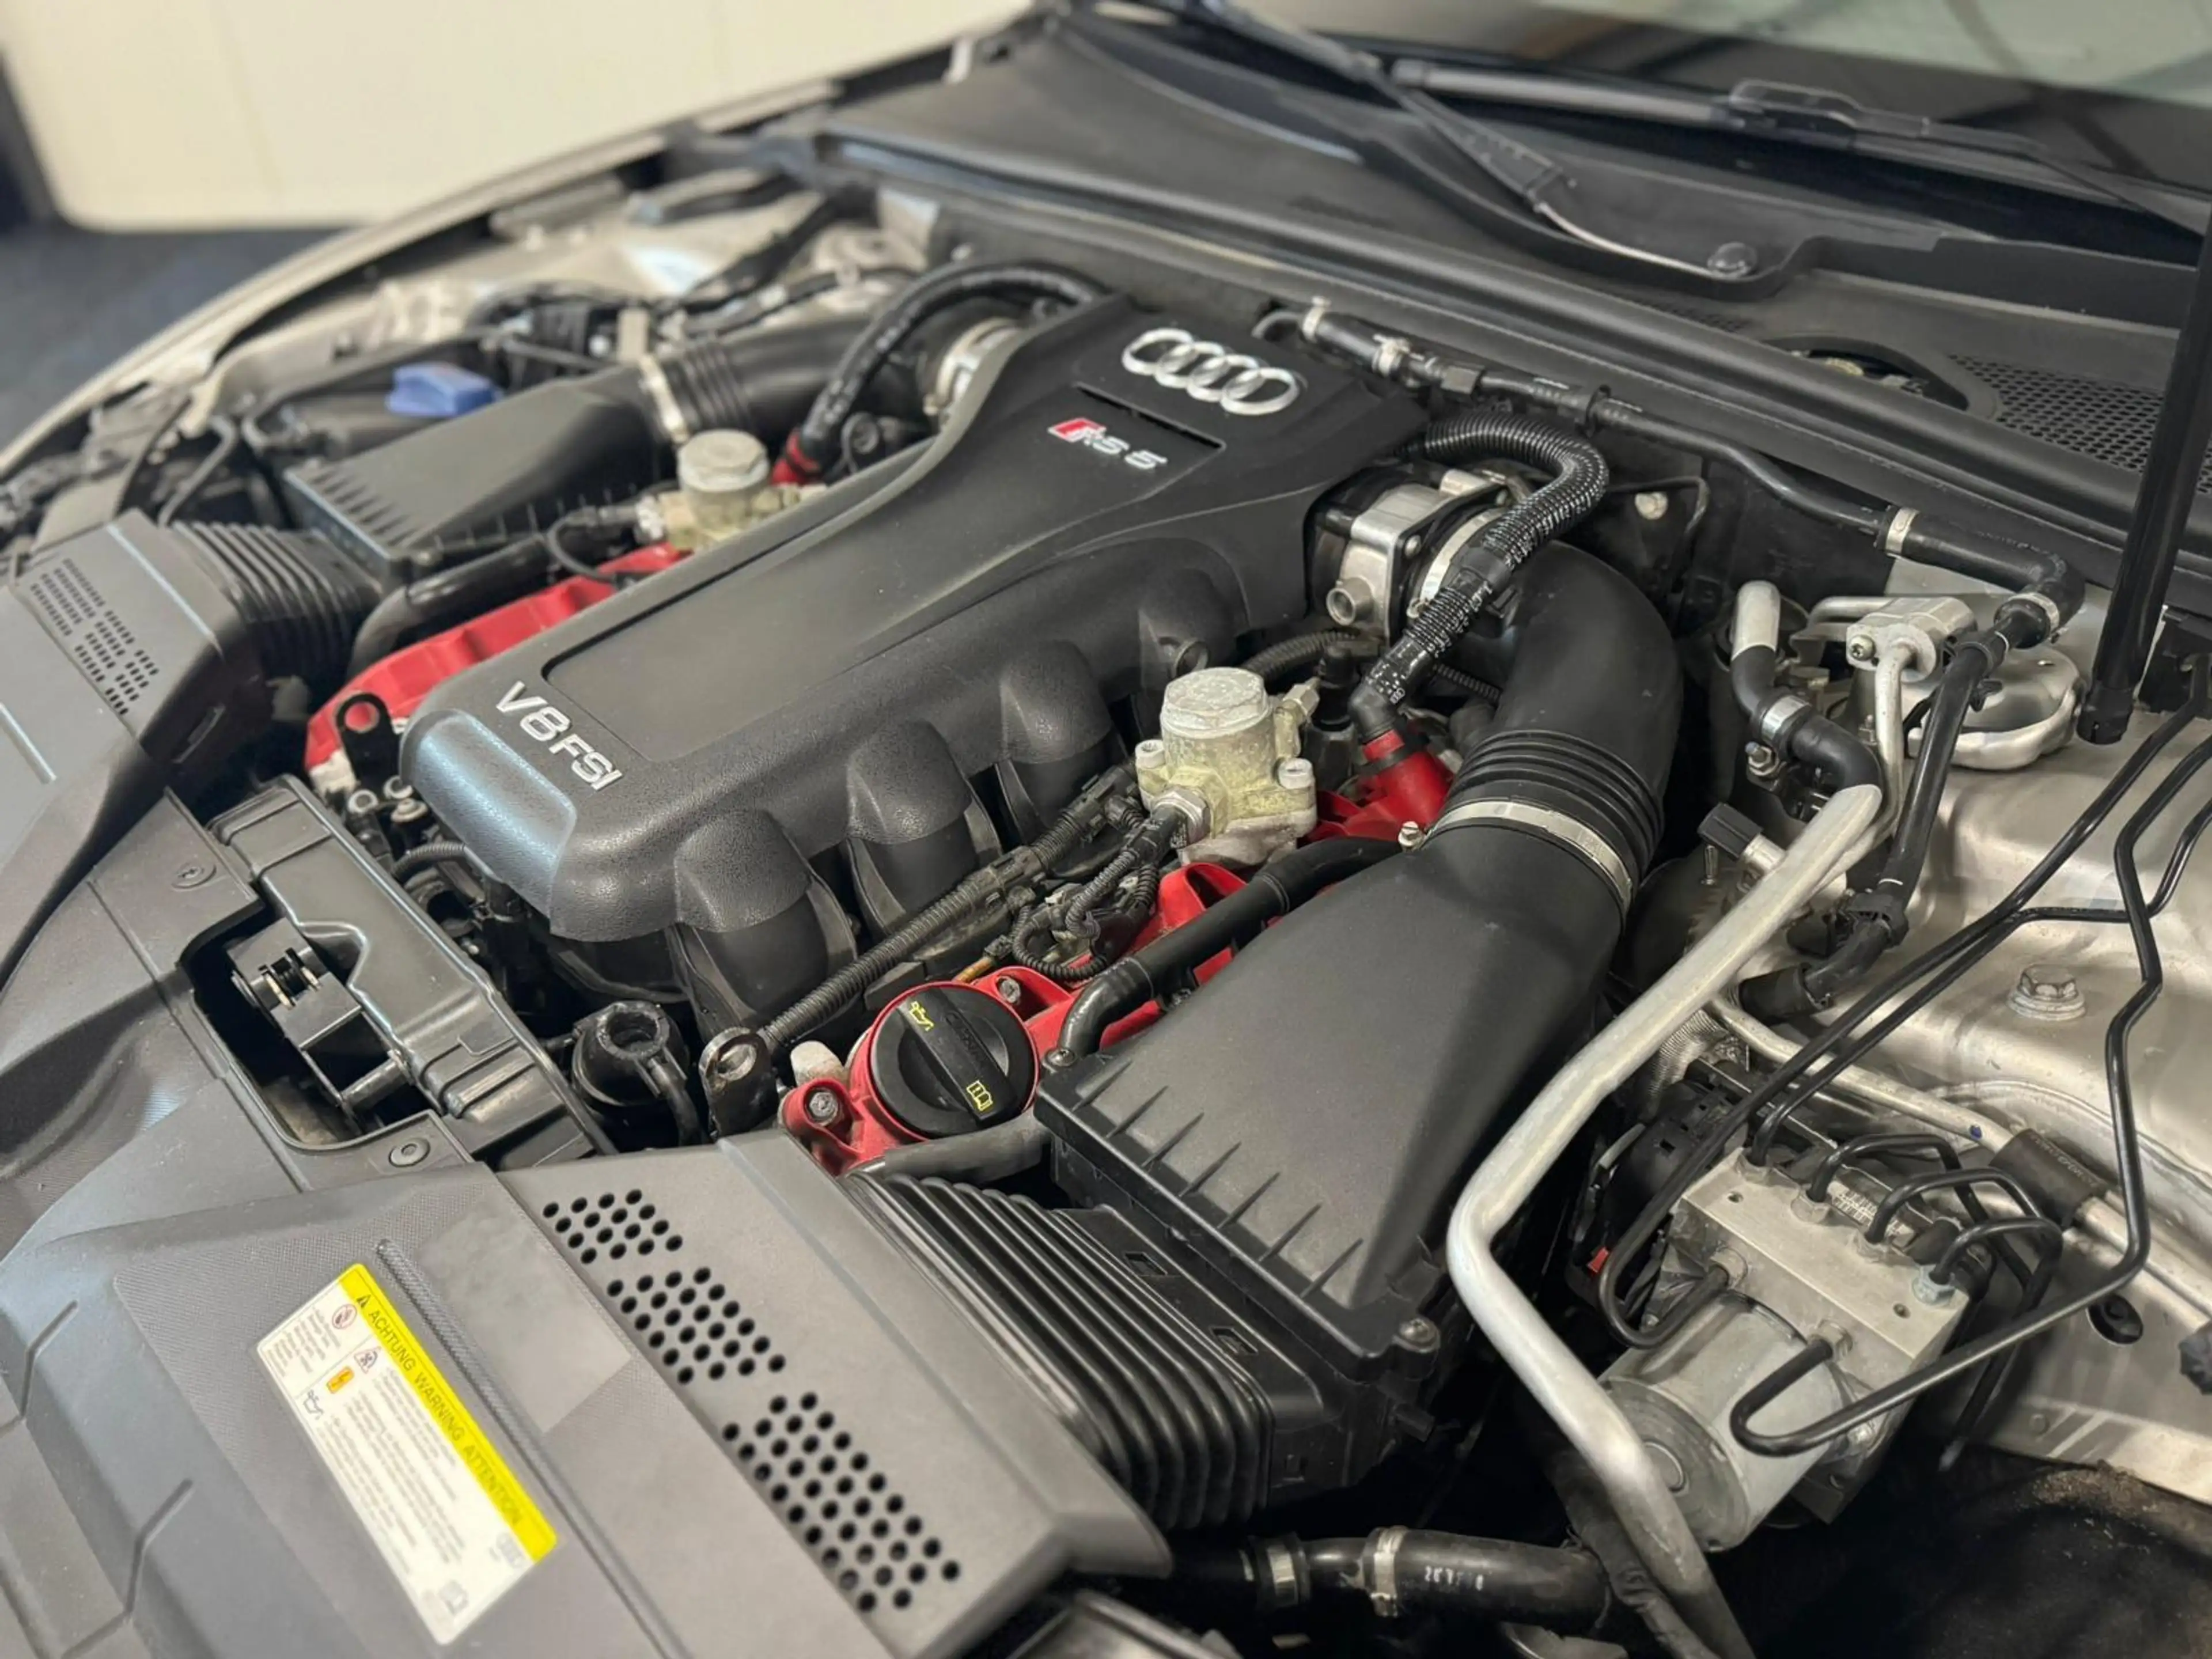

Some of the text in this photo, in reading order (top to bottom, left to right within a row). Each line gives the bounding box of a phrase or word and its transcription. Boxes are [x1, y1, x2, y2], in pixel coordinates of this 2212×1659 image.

[368, 1308, 417, 1372] ACHTUNG
[414, 1372, 465, 1441] WARNING
[463, 1444, 522, 1525] ATTENTION
